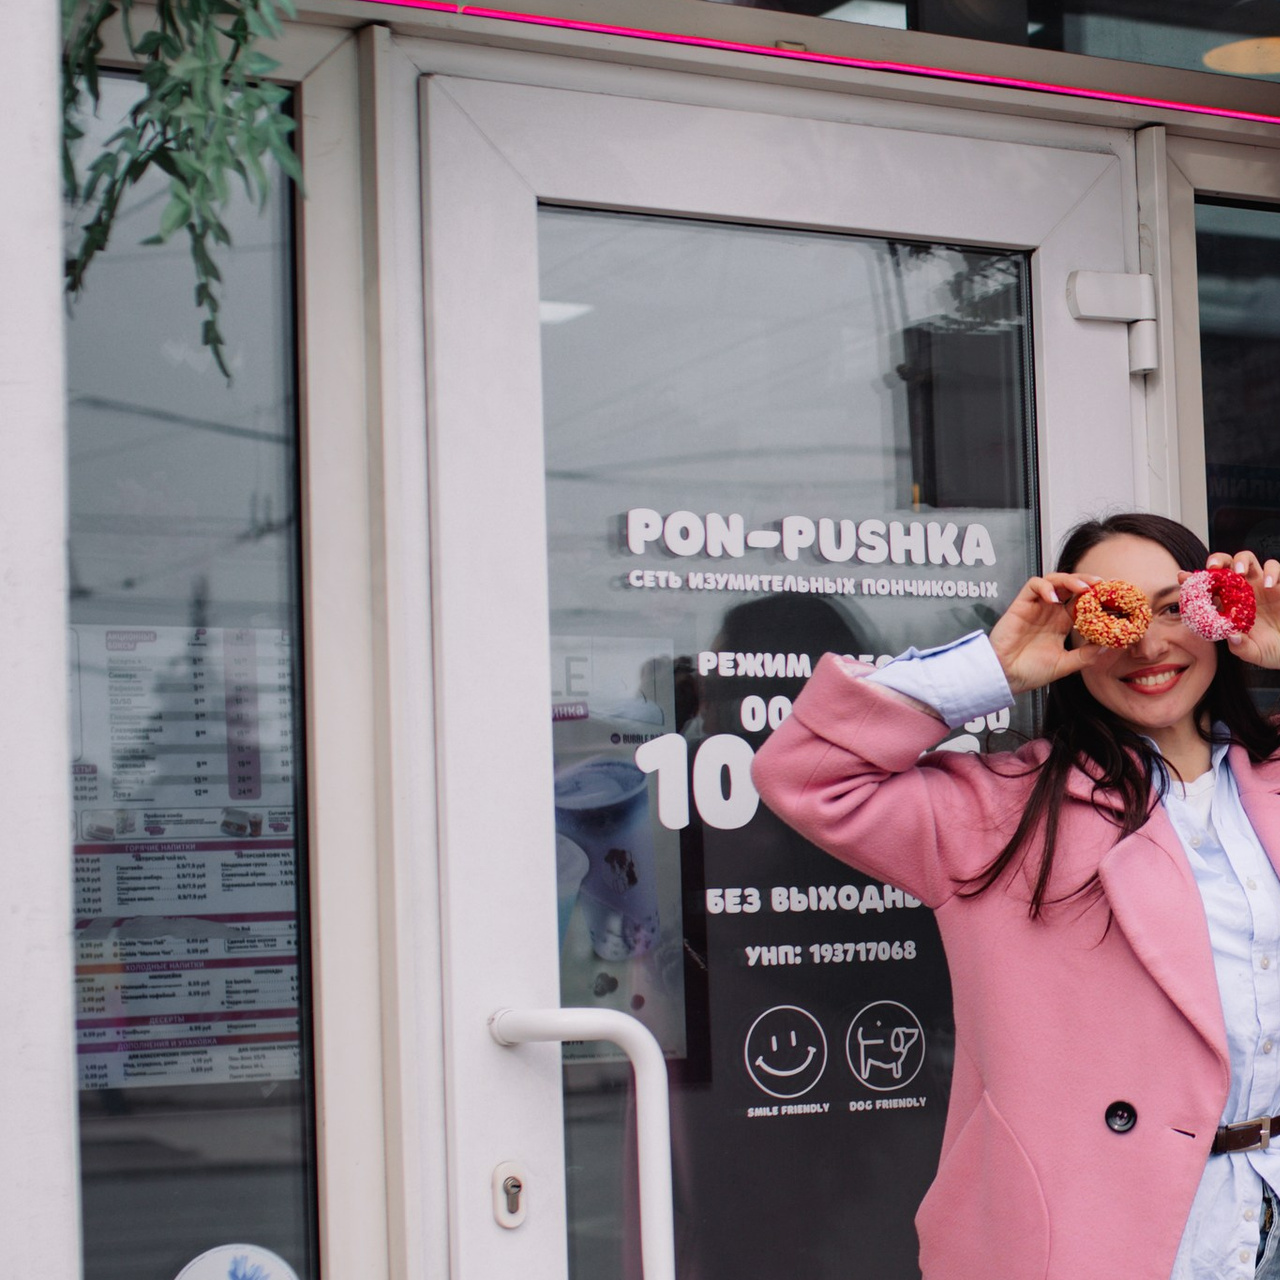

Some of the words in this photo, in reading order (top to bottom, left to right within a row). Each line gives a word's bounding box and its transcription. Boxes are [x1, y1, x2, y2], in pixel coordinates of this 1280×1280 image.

[627, 508, 997, 566] PON-PUSHKA
[628, 569, 683, 590] СЕТЬ
[688, 571, 856, 595] ИЗУМИТЕЛЬНЫХ
[861, 578, 999, 599] ПОНЧИКОВЫХ
[698, 651, 812, 678] РЕЖИМ
[634, 732, 760, 830] 10
[161, 843, 196, 851] НАПИТКИ
[705, 886, 762, 914] БЕЗ
[745, 944, 803, 967] УНП:
[809, 940, 918, 964] 193717068
[126, 963, 167, 972] ХОЛОДНЫЕ
[169, 961, 205, 969] НАПИТКИ
[149, 1015, 185, 1025] ДЕСЕРТЫ
[117, 1041, 169, 1051] ДОПОЛНЕНИЯ
[178, 1037, 217, 1047] УПАКОВКА
[747, 1106, 779, 1118] SMILE
[781, 1102, 830, 1116] FRIENDLY
[849, 1100, 874, 1112] DOG
[876, 1096, 927, 1110] FRIENDLY
